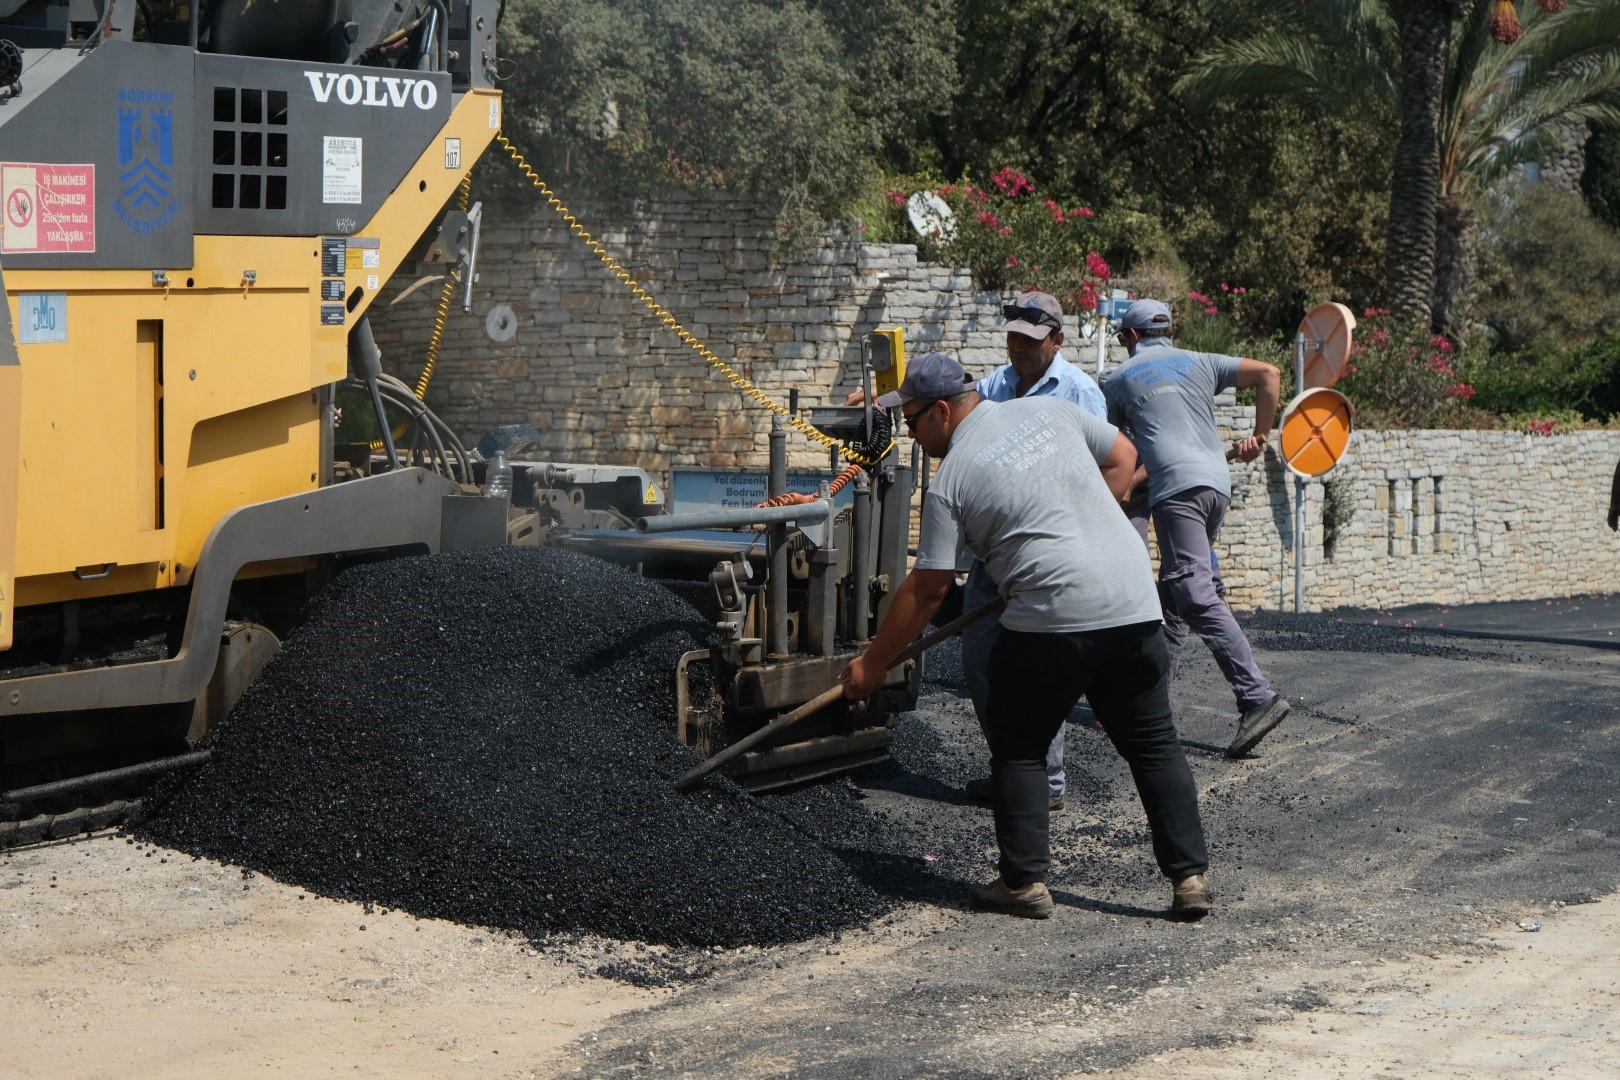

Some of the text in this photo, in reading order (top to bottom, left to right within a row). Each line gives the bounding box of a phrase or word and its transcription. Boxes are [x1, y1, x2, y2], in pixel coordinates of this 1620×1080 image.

[118, 88, 173, 104] BODRUM
[304, 71, 437, 110] VOLVO
[446, 151, 458, 167] 107
[44, 173, 87, 186] İŞ MAKİNESİ
[44, 193, 86, 206] ÇALIŞIRKEN
[71, 212, 88, 223] fazla
[47, 231, 84, 244] YAKLAŞMA
[973, 436, 1012, 468] BODRUM
[995, 425, 1057, 468] FEN İŞLERİ
[714, 475, 728, 485] Yol
[726, 487, 765, 497] Bodrum
[721, 499, 740, 509] Fen
